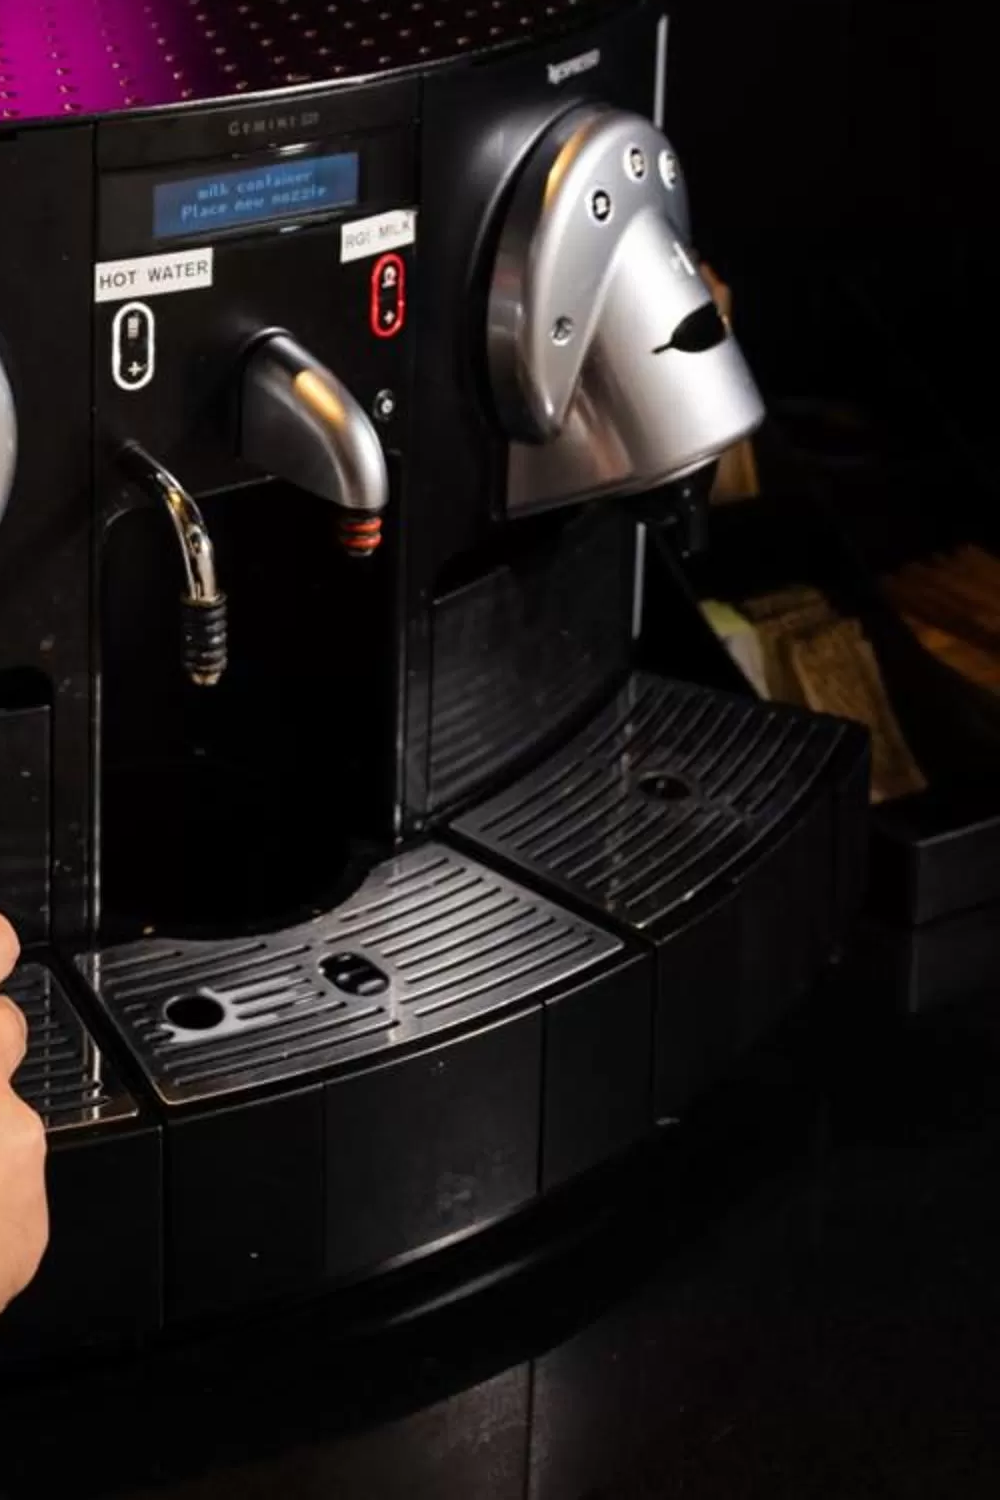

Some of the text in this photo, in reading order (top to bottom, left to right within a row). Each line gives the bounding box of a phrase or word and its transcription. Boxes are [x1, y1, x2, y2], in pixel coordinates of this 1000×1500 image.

[197, 182, 228, 200] milk
[181, 204, 228, 223] Place
[99, 260, 209, 289] HOT WATER
